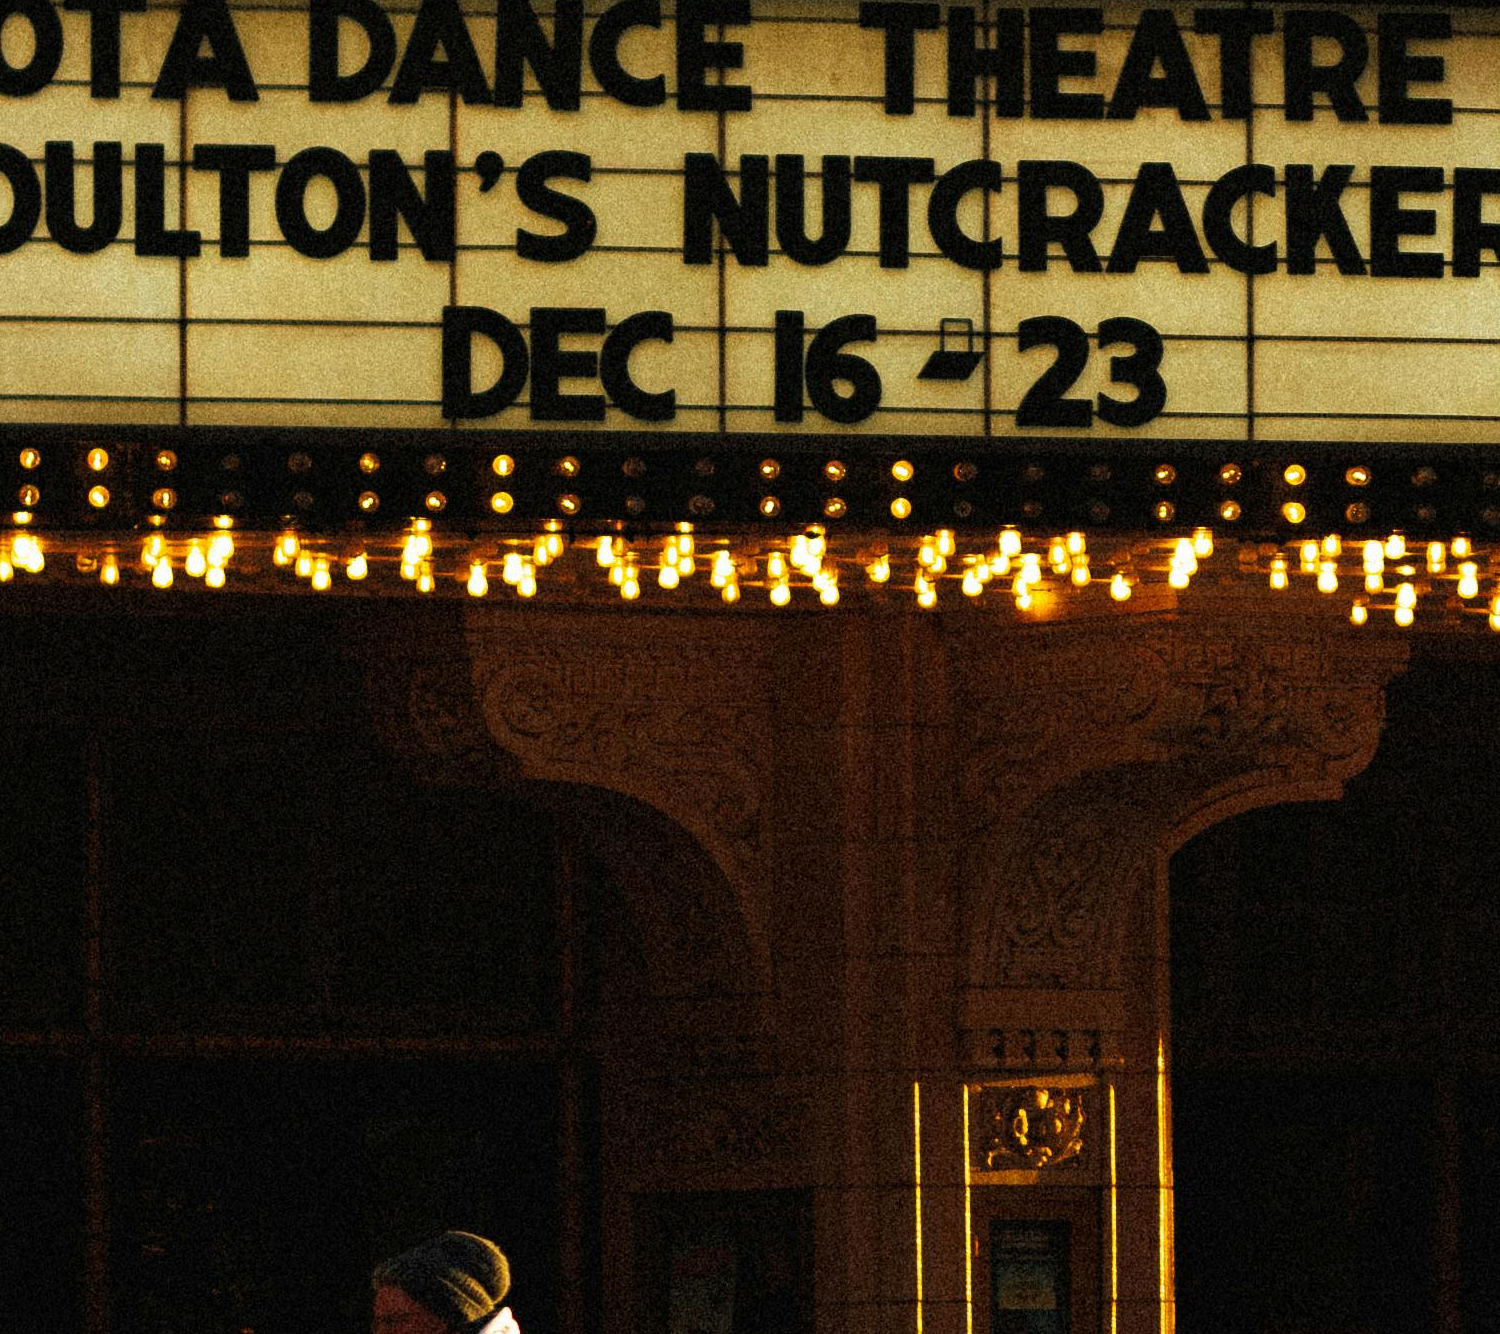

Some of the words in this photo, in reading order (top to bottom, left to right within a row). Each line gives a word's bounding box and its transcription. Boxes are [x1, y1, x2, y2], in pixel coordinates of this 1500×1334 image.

[859, 1, 1454, 125] THEATRE
[441, 305, 676, 424] DEC
[773, 310, 882, 425] 16
[1016, 316, 1166, 428] 23
